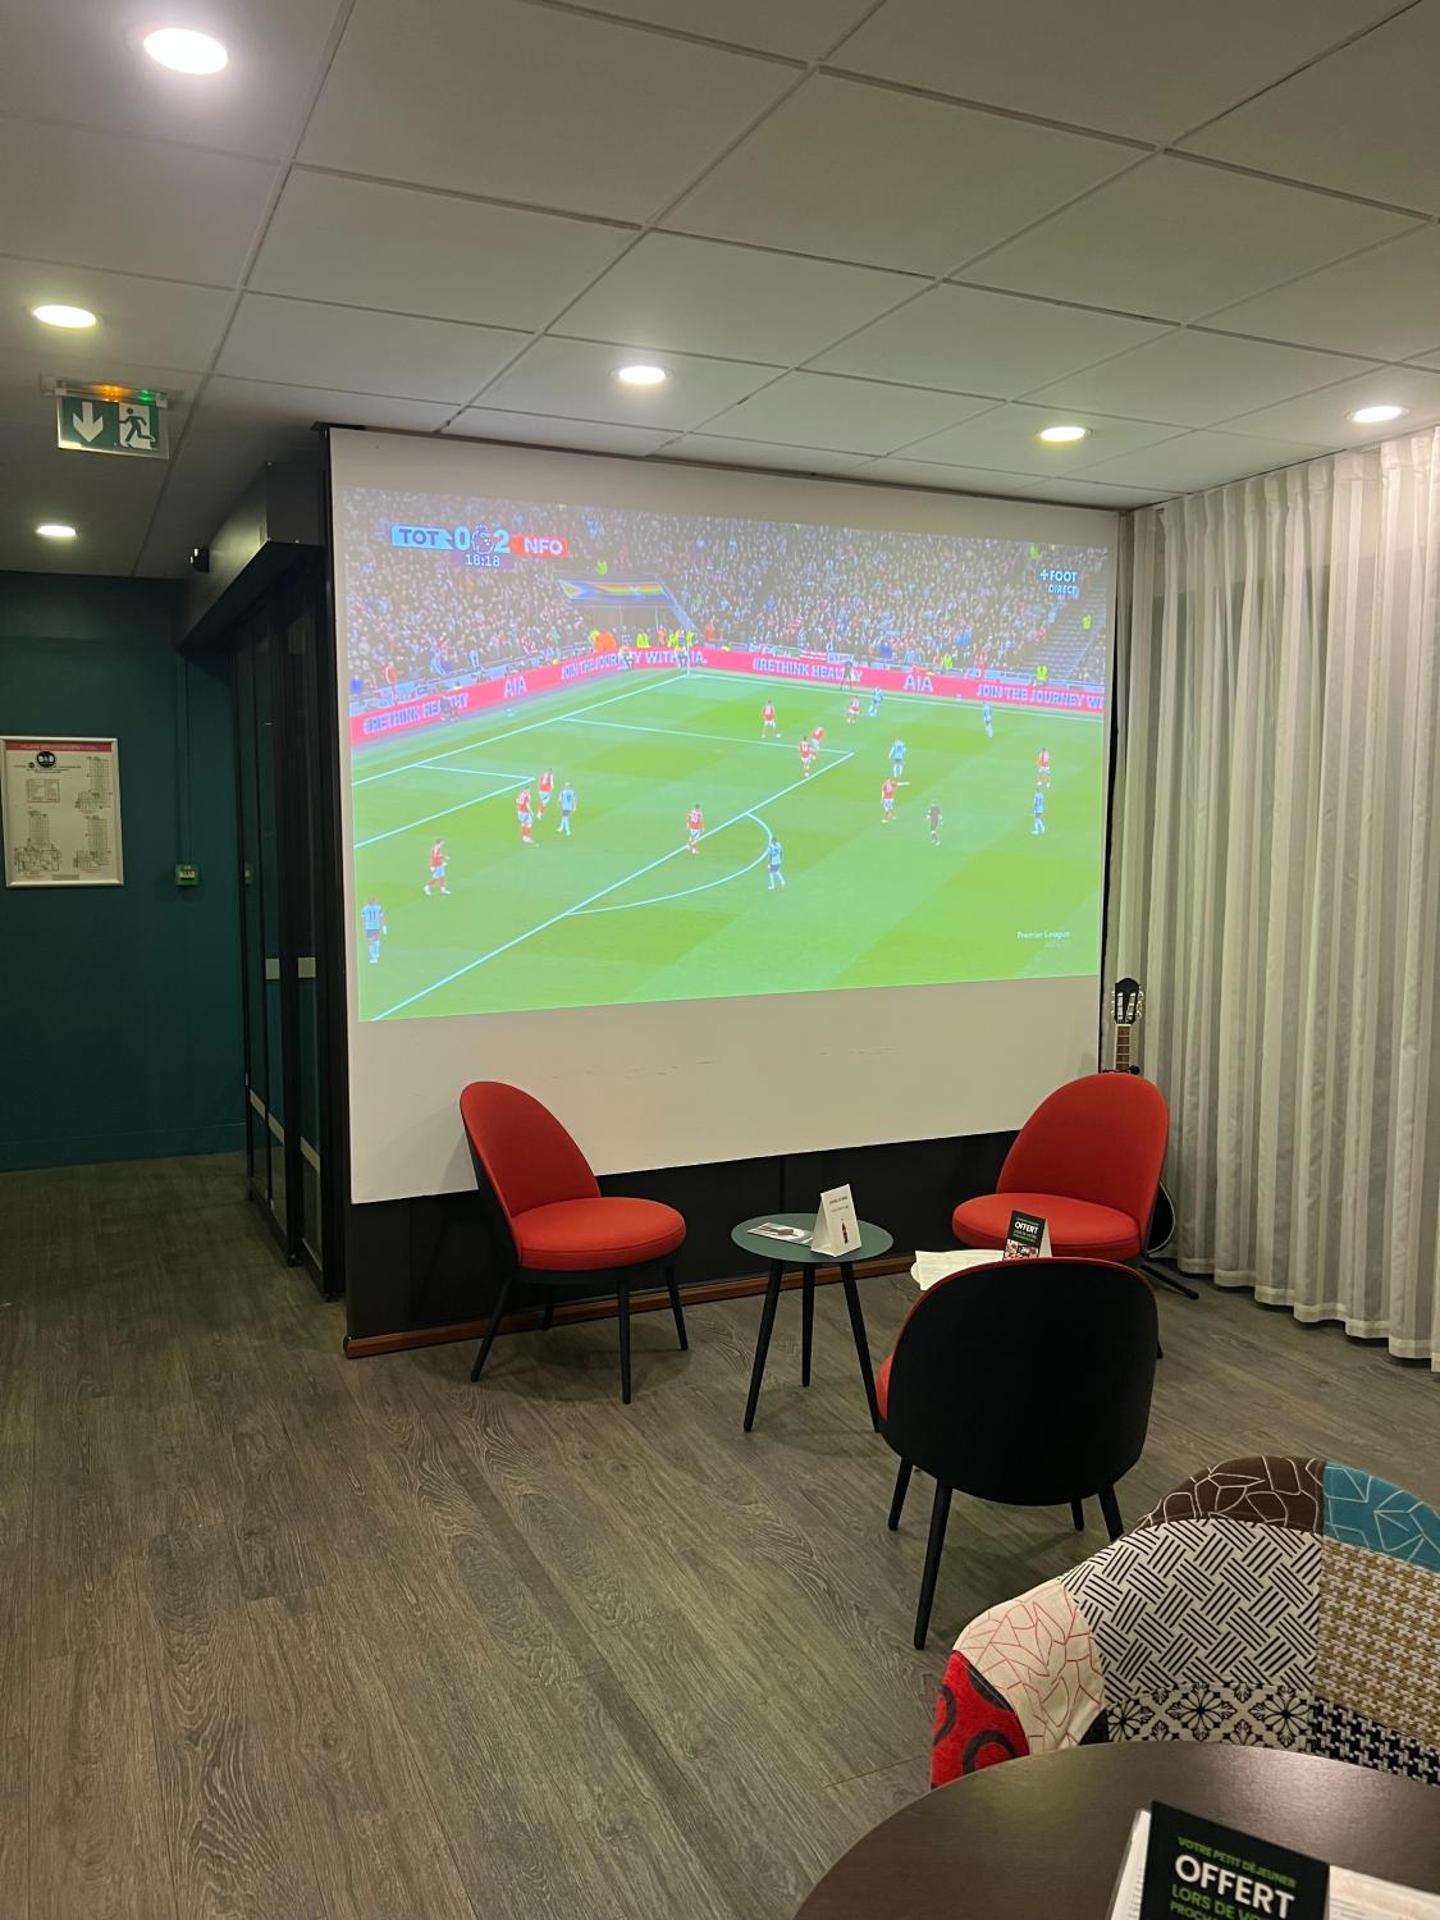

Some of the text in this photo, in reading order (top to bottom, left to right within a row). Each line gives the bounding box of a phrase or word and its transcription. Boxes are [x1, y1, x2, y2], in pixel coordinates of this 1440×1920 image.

[399, 526, 563, 555] TOT 0 2 NFO
[465, 554, 500, 567] 18:18
[503, 676, 527, 698] AIA
[904, 674, 934, 692] AIA
[976, 683, 1003, 698] JOIN
[1005, 687, 1028, 701] THE
[1177, 1836, 1212, 1857] VOTRE
[1213, 1850, 1240, 1868] PETIT
[1174, 1854, 1296, 1919] OFFERT
[1171, 1883, 1212, 1910] LORS
[1214, 1900, 1236, 1920] DE
